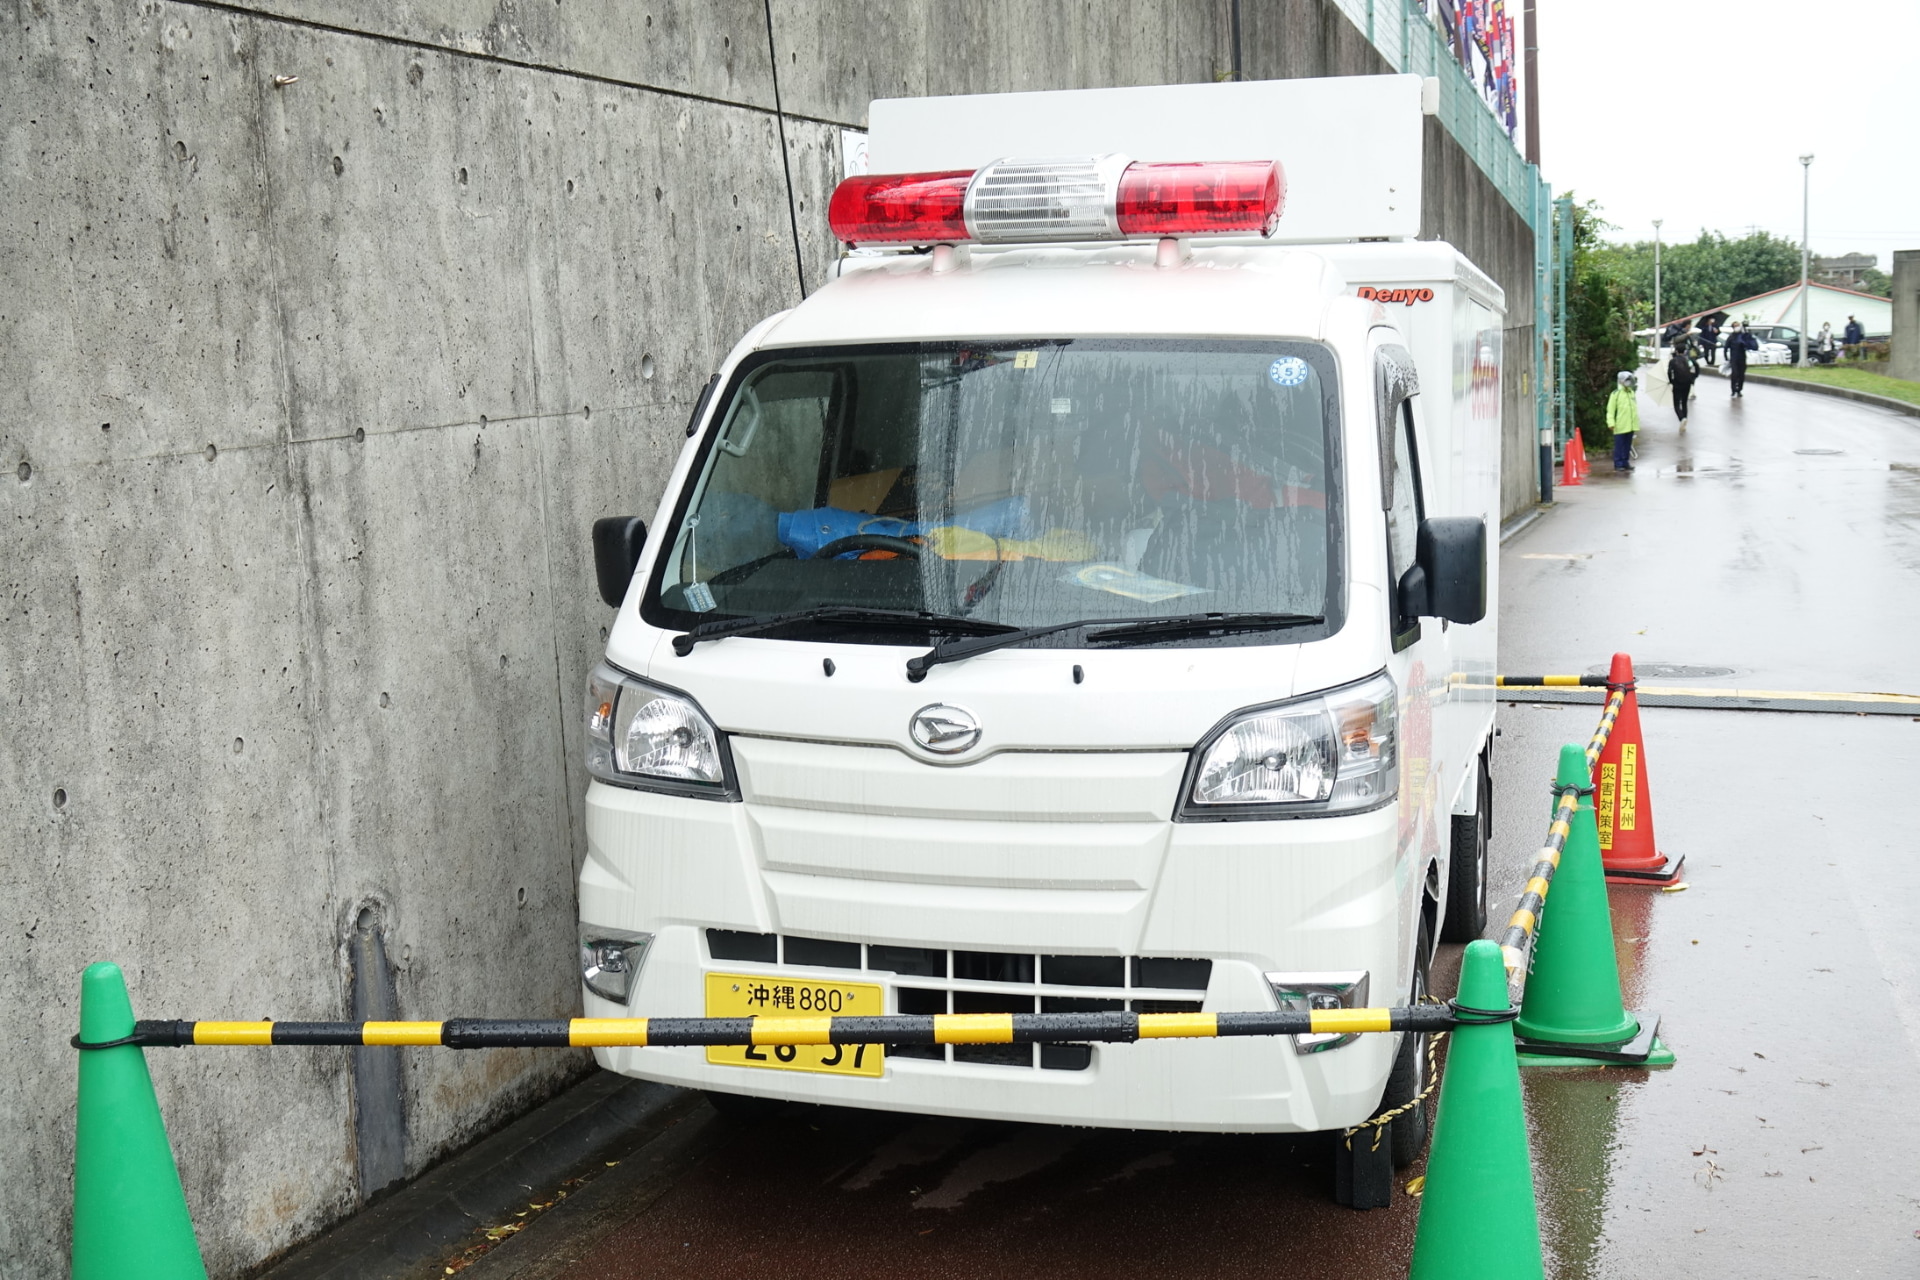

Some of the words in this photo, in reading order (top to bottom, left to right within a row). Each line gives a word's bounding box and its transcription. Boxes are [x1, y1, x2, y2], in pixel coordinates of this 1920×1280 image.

[1357, 287, 1434, 306] Denyo
[1285, 367, 1294, 377] 5
[1599, 766, 1615, 845] 災害対策室
[1620, 745, 1635, 827] ドコモ九州
